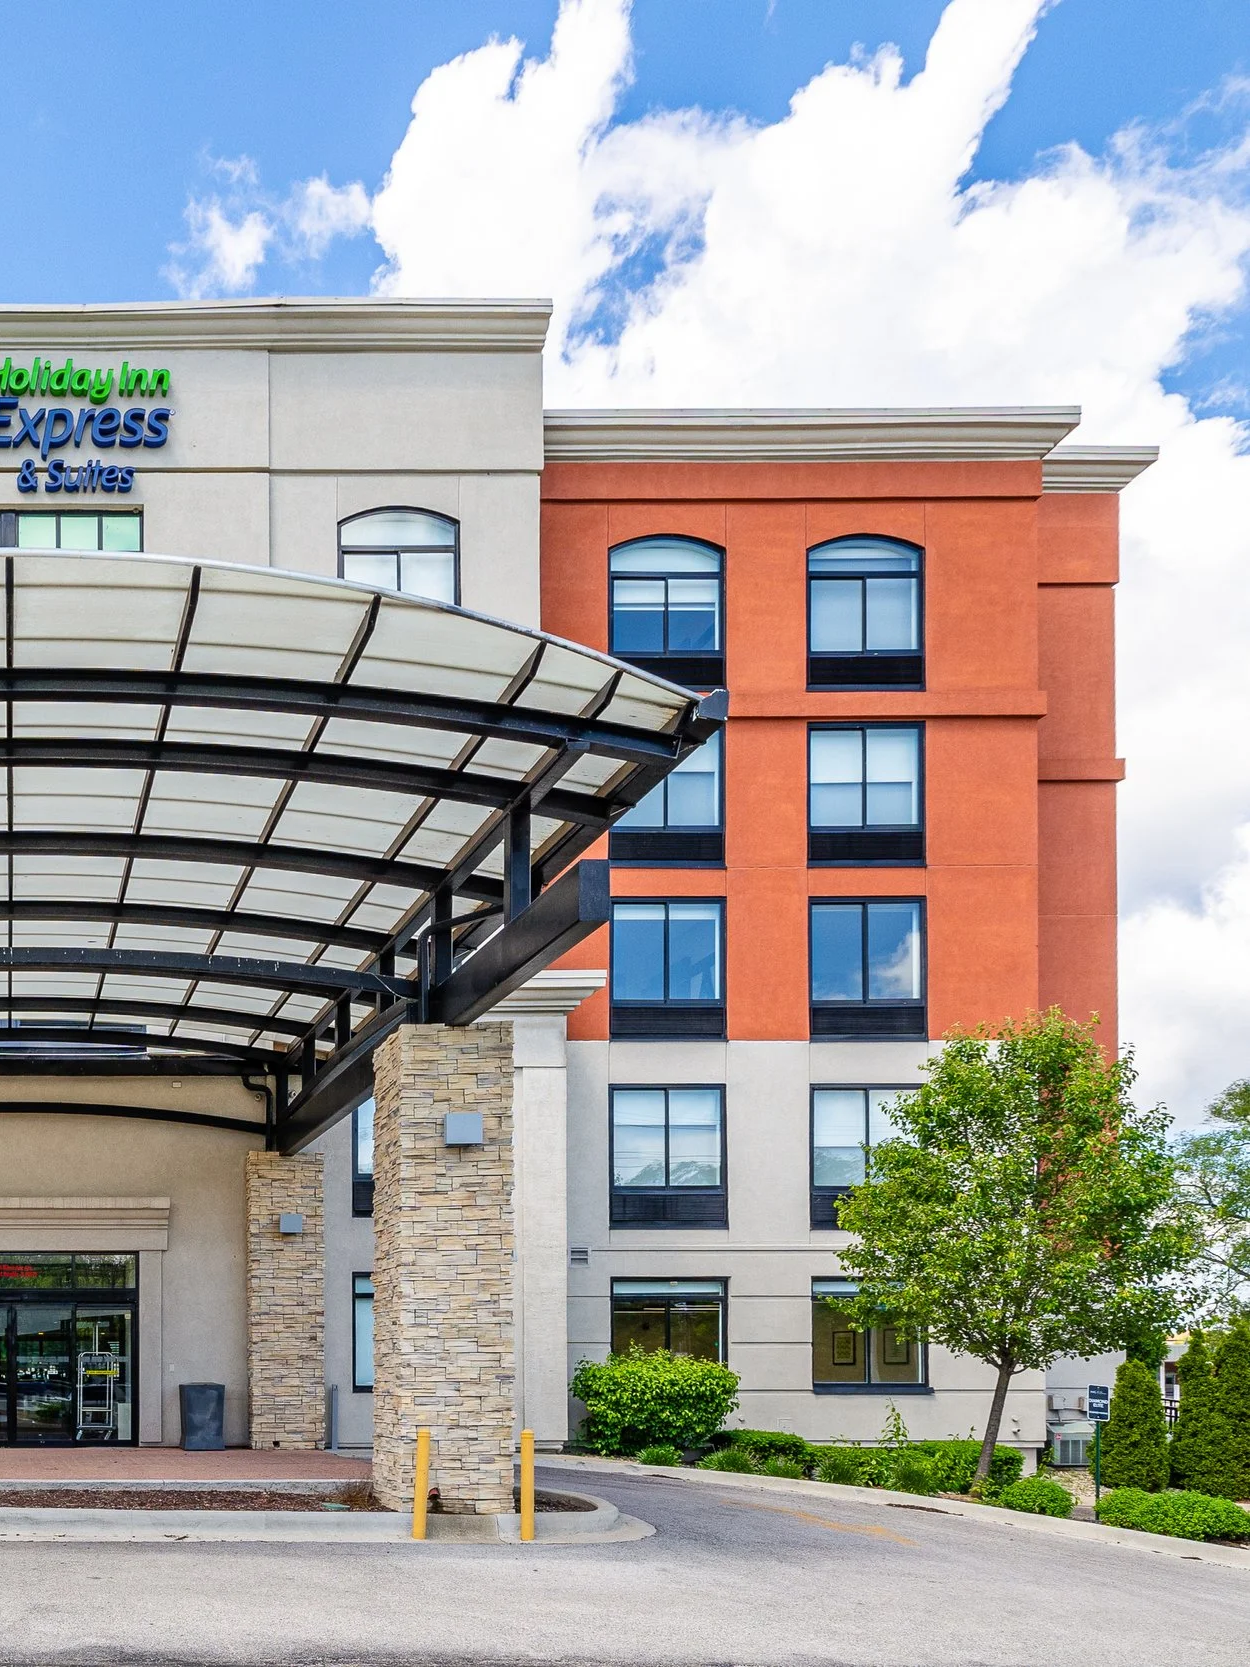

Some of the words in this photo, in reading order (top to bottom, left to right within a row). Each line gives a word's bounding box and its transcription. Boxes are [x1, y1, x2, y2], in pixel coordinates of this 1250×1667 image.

[118, 361, 171, 397] Inn
[17, 459, 38, 493] &
[45, 459, 136, 493] Suites
